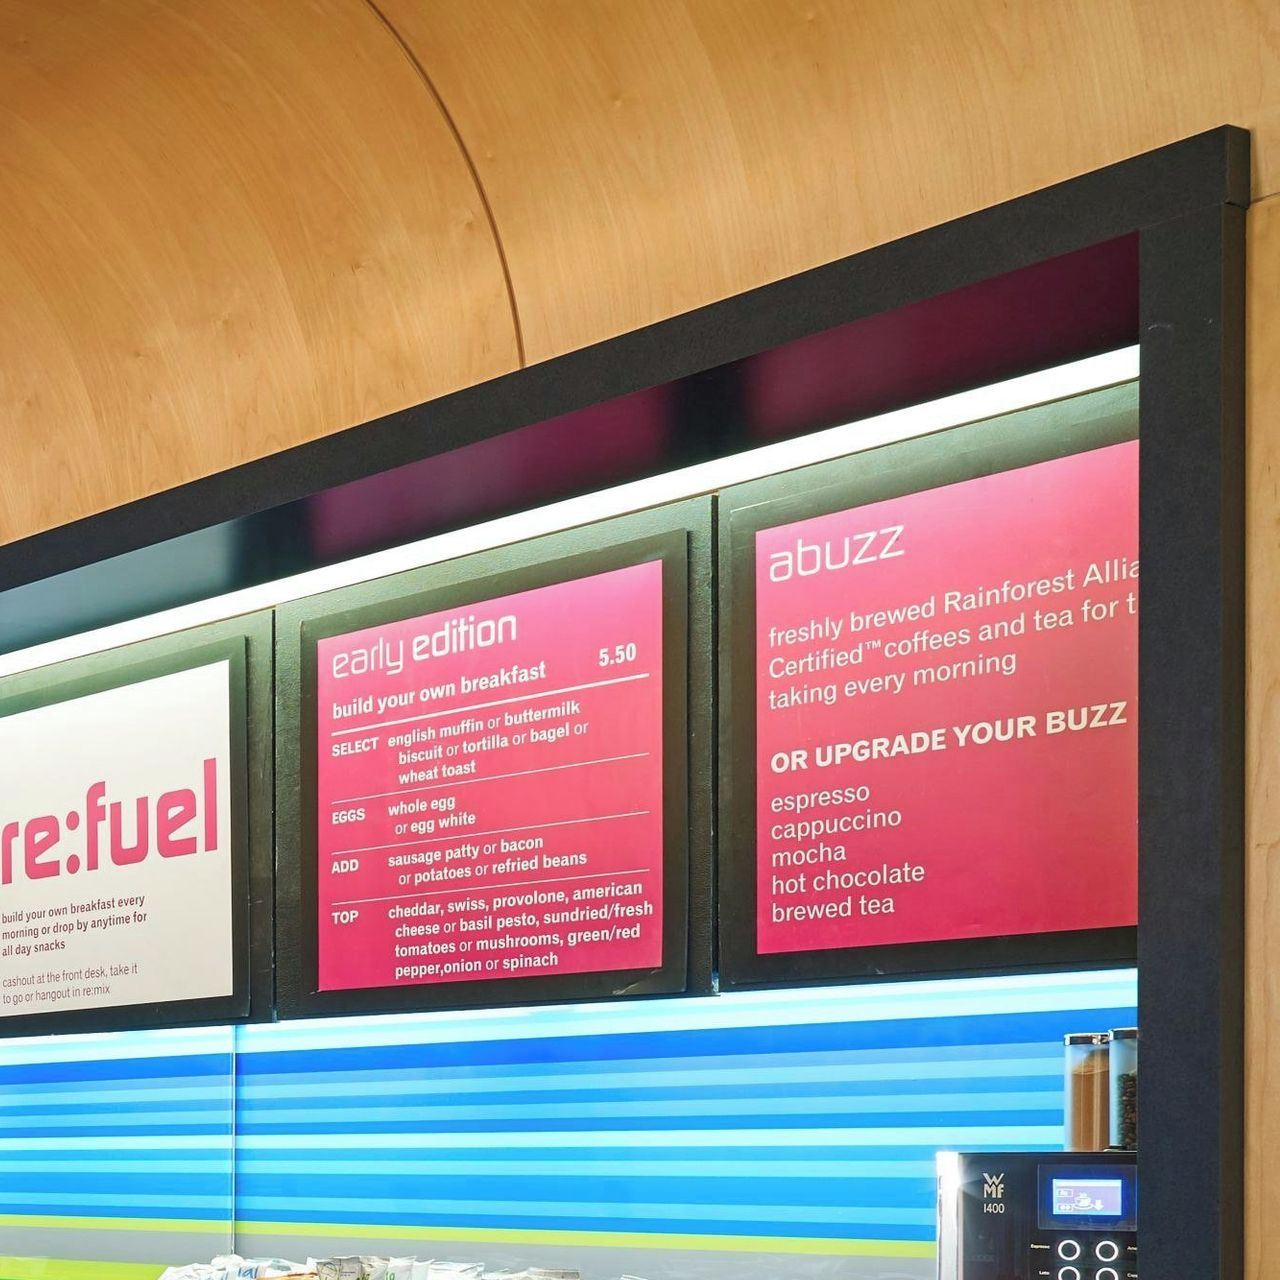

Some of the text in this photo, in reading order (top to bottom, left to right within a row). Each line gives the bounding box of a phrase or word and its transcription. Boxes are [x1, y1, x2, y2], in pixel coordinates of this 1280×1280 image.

[769, 524, 904, 582] abuzz
[768, 616, 843, 647] freshly
[850, 595, 935, 632] brewed
[944, 568, 1074, 613] Rainforest
[884, 628, 970, 658] coffees
[978, 612, 1024, 641] and
[1033, 609, 1074, 631] tea
[1081, 599, 1119, 622] for
[332, 614, 516, 678] early edition
[598, 642, 636, 667] 5.50
[333, 660, 546, 719] build your own breakfast
[768, 653, 1016, 709] taking every morning
[331, 700, 580, 757] SELECT english muffin or buttermilk
[398, 722, 589, 764] biscuit or tortilla or bagel or
[770, 701, 1127, 773] OR UPGRADE YOUR BUZZ
[398, 759, 476, 784] wheat toast
[332, 797, 455, 824] EGGS whole egg
[771, 785, 870, 813] espresso
[1, 757, 218, 885] re:fuel
[394, 811, 476, 835] or egg white
[771, 809, 902, 841] cappuccino
[331, 837, 543, 874] ADD sausage patty or bacon
[398, 853, 587, 886] or potatoes or refried beans
[772, 842, 846, 867] mocha
[772, 862, 925, 895] hot chocolate
[1, 895, 145, 924] build your own breakfast every
[331, 882, 642, 924] TOP cheddar, swiss, provolone, american
[395, 900, 653, 937] cheese or basil pesto, sundried/fresh
[772, 895, 895, 922] brewed tea
[2, 910, 147, 940] morning or drop by anytime for
[394, 922, 640, 957] tomatoes or mushrooms, green/red
[1, 939, 65, 957] all day snacks
[2, 963, 137, 988] cashout at the front desk, take it
[395, 951, 558, 980] pepper,onion or spinach
[2, 986, 110, 1006] to go or hangout in re:mix
